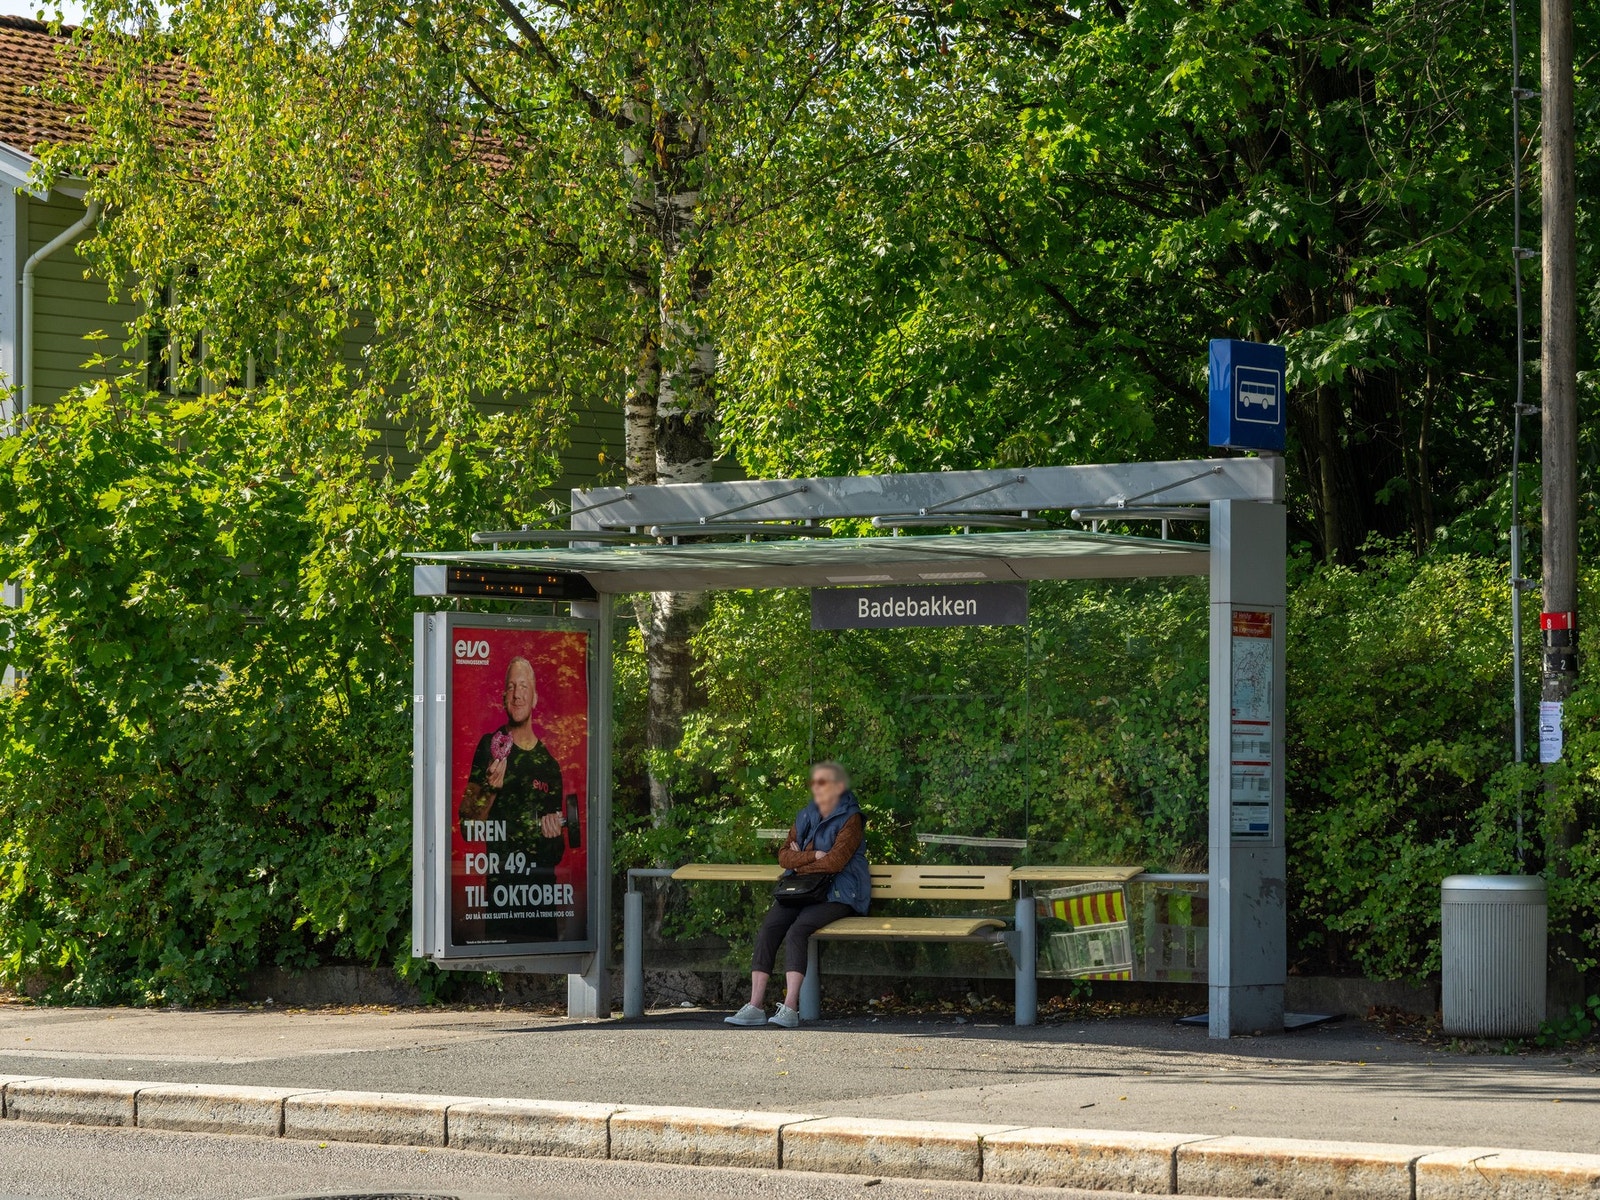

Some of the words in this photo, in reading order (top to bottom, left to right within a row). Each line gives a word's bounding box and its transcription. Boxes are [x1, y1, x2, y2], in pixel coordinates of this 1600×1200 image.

[858, 596, 977, 618] Badebakken
[454, 640, 490, 658] evo
[1560, 660, 1566, 670] 2
[464, 820, 506, 842] TREN
[465, 852, 500, 874] FOR
[504, 852, 537, 876] 49,-
[464, 885, 488, 908] TIL
[493, 884, 574, 906] OKTOBER
[473, 912, 481, 920] MÅ
[509, 910, 513, 918] Å
[536, 910, 540, 918] Å
